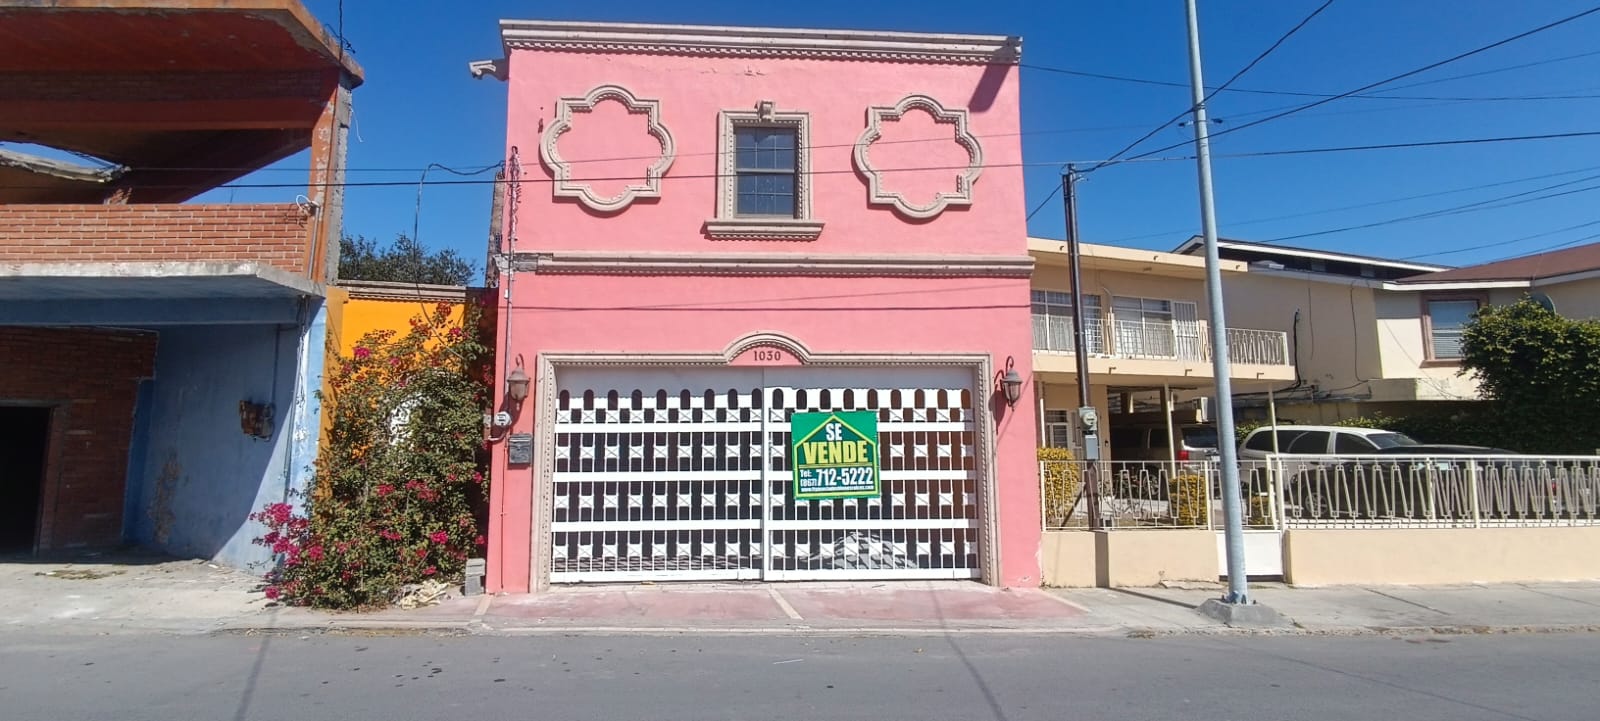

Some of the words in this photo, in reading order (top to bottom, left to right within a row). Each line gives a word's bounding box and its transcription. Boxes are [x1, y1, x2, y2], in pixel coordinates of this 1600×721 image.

[753, 350, 781, 361] 1030
[826, 423, 842, 441] SE
[803, 440, 868, 464] VENDE
[816, 467, 874, 486] 712-5222
